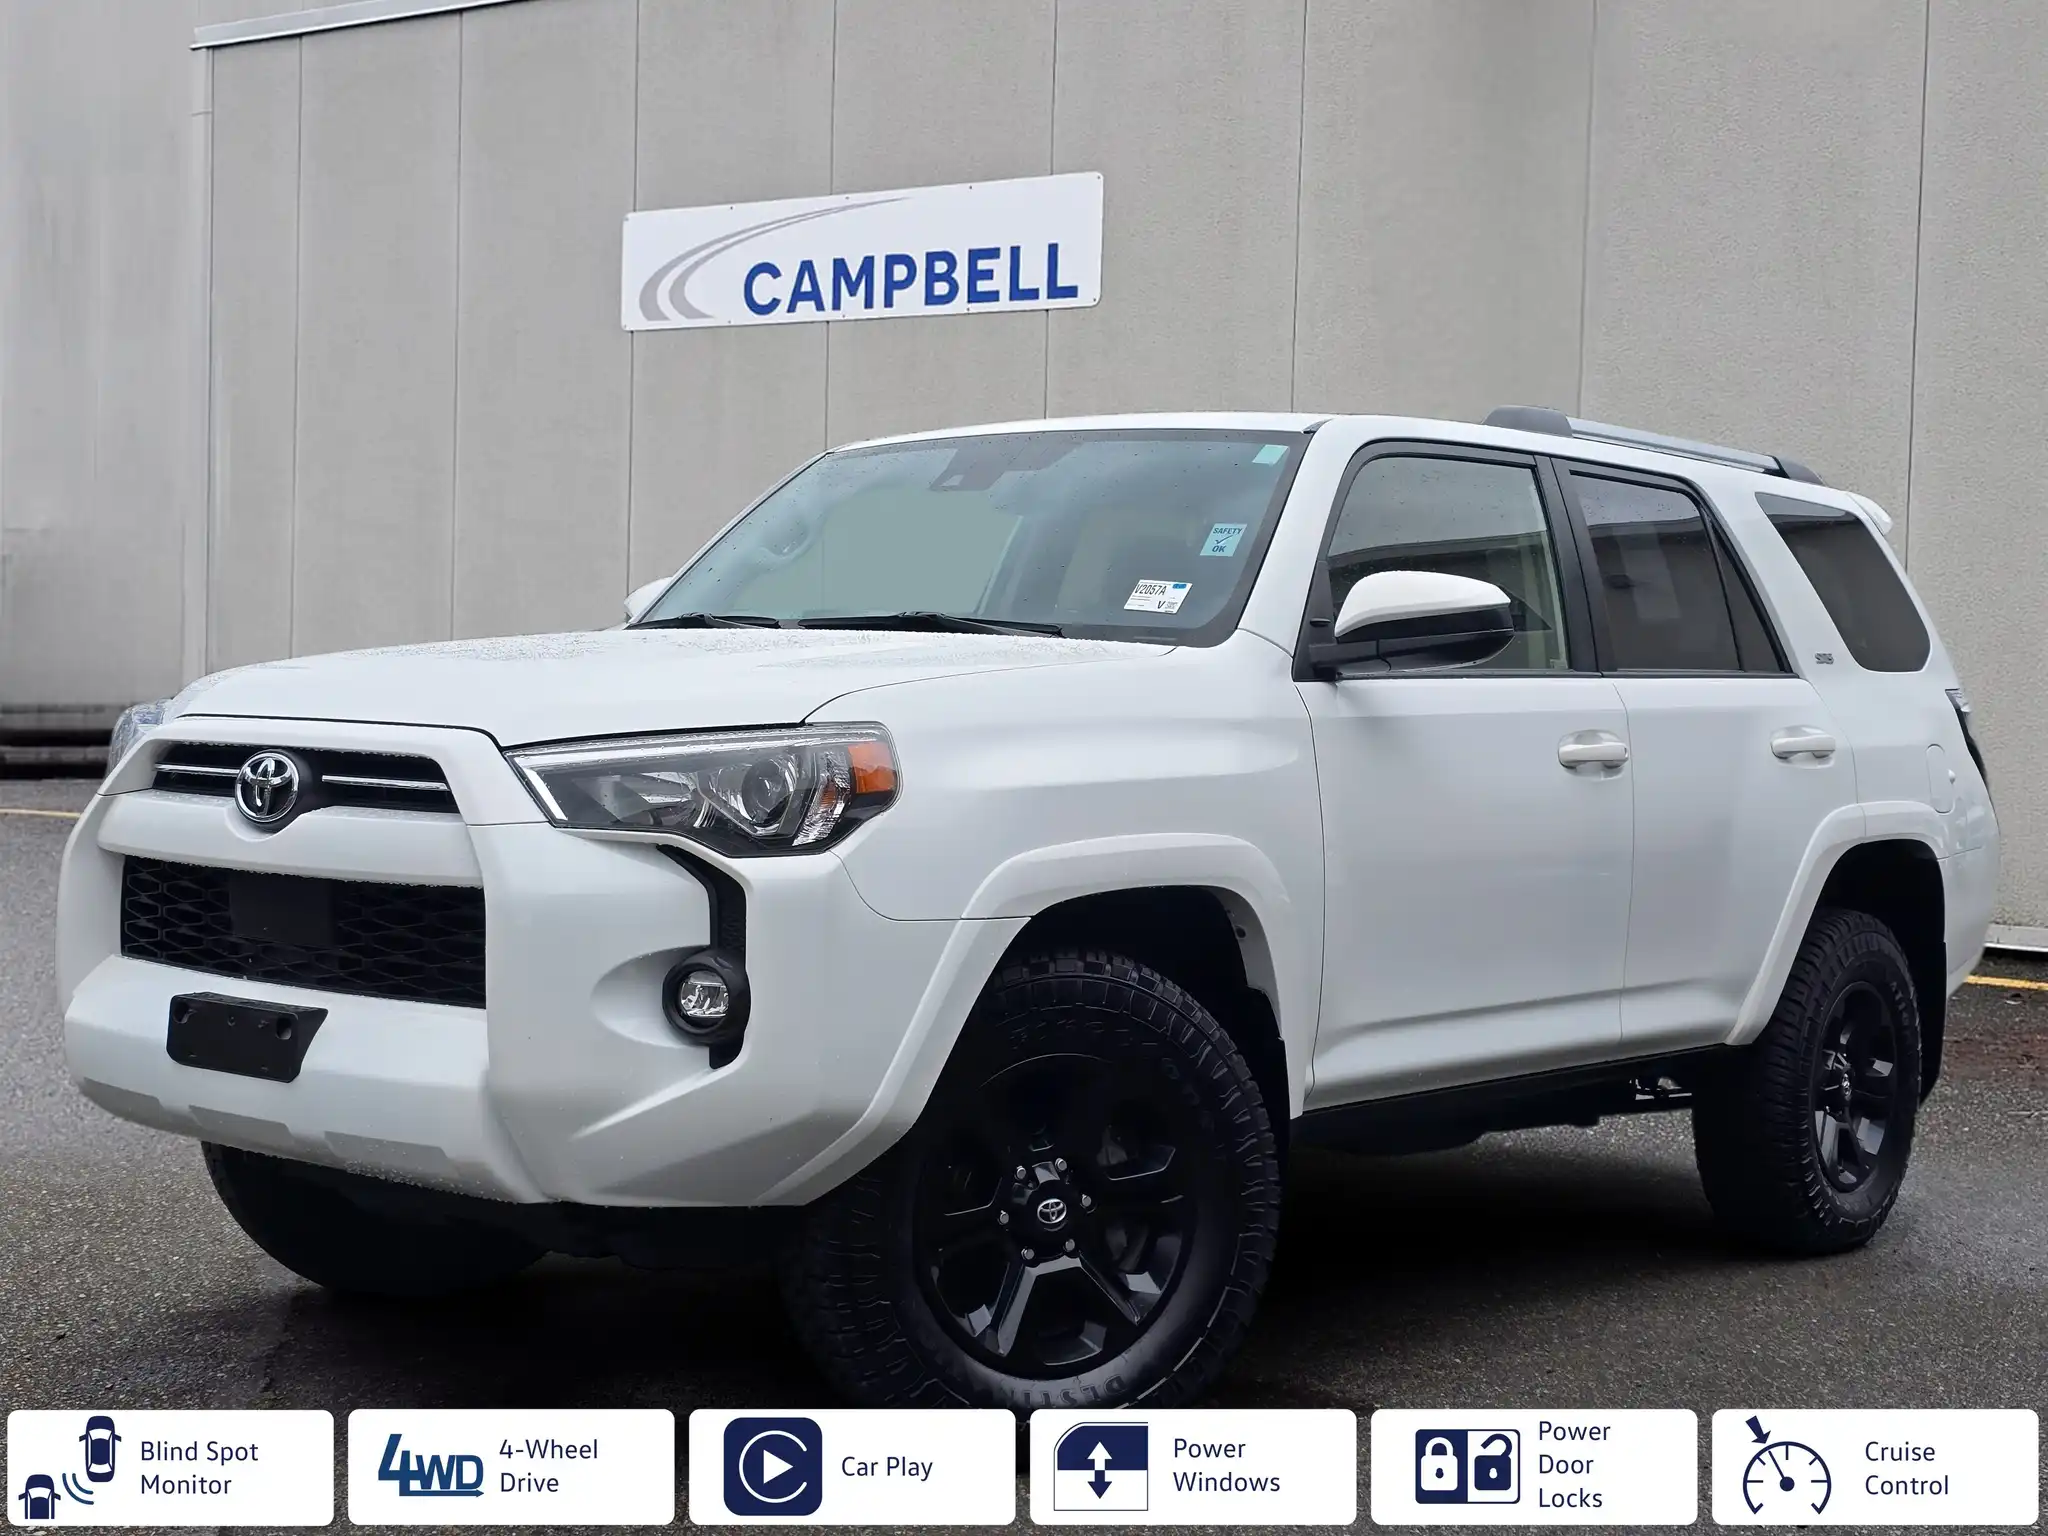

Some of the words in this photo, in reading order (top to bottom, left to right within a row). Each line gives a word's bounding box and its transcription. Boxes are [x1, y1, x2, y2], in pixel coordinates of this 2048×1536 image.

[744, 242, 1079, 316] CAMPBELL
[1212, 545, 1227, 553] OK
[1134, 584, 1167, 596] V2057A
